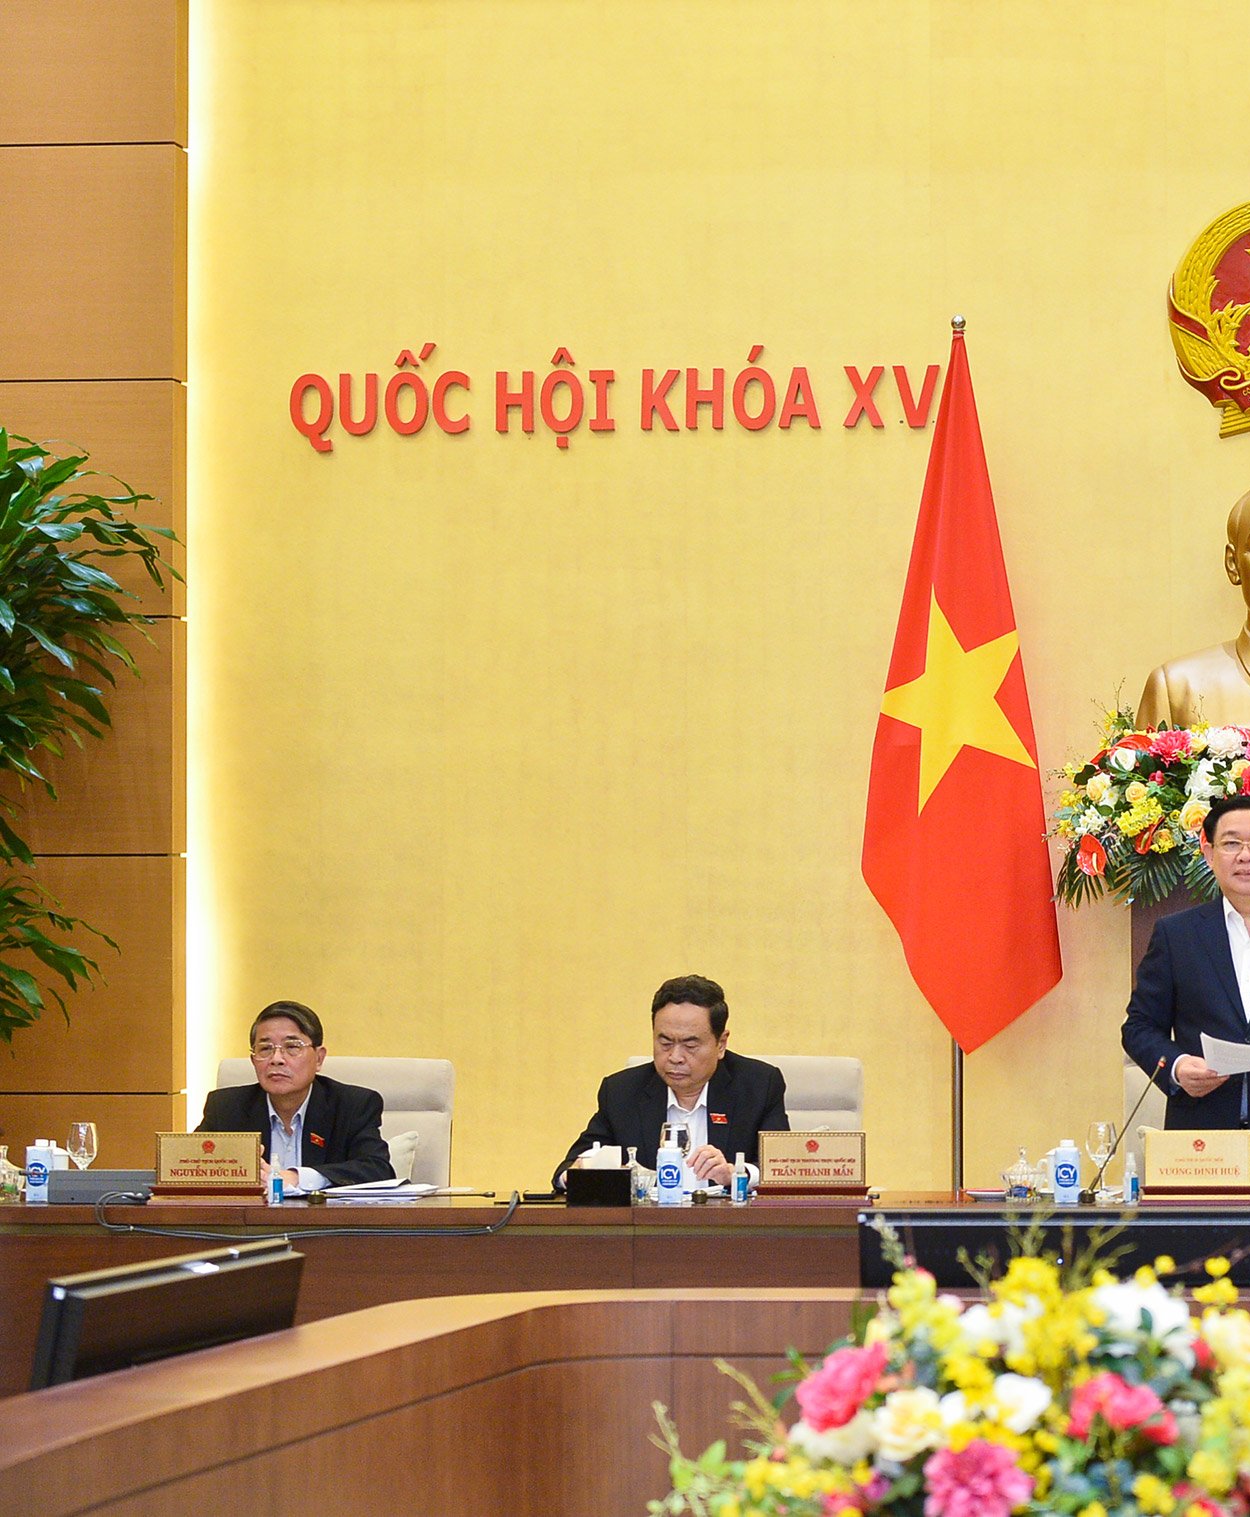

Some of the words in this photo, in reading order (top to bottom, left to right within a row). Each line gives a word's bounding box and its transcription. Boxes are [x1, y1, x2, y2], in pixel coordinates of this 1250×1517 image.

[289, 342, 470, 452] QUỐC
[495, 347, 616, 448] HỘI
[640, 345, 821, 431] KHÓA
[843, 364, 940, 428] XV
[660, 1168, 679, 1180] ICY
[798, 1168, 831, 1176] THANH
[1057, 1167, 1075, 1179] ICY
